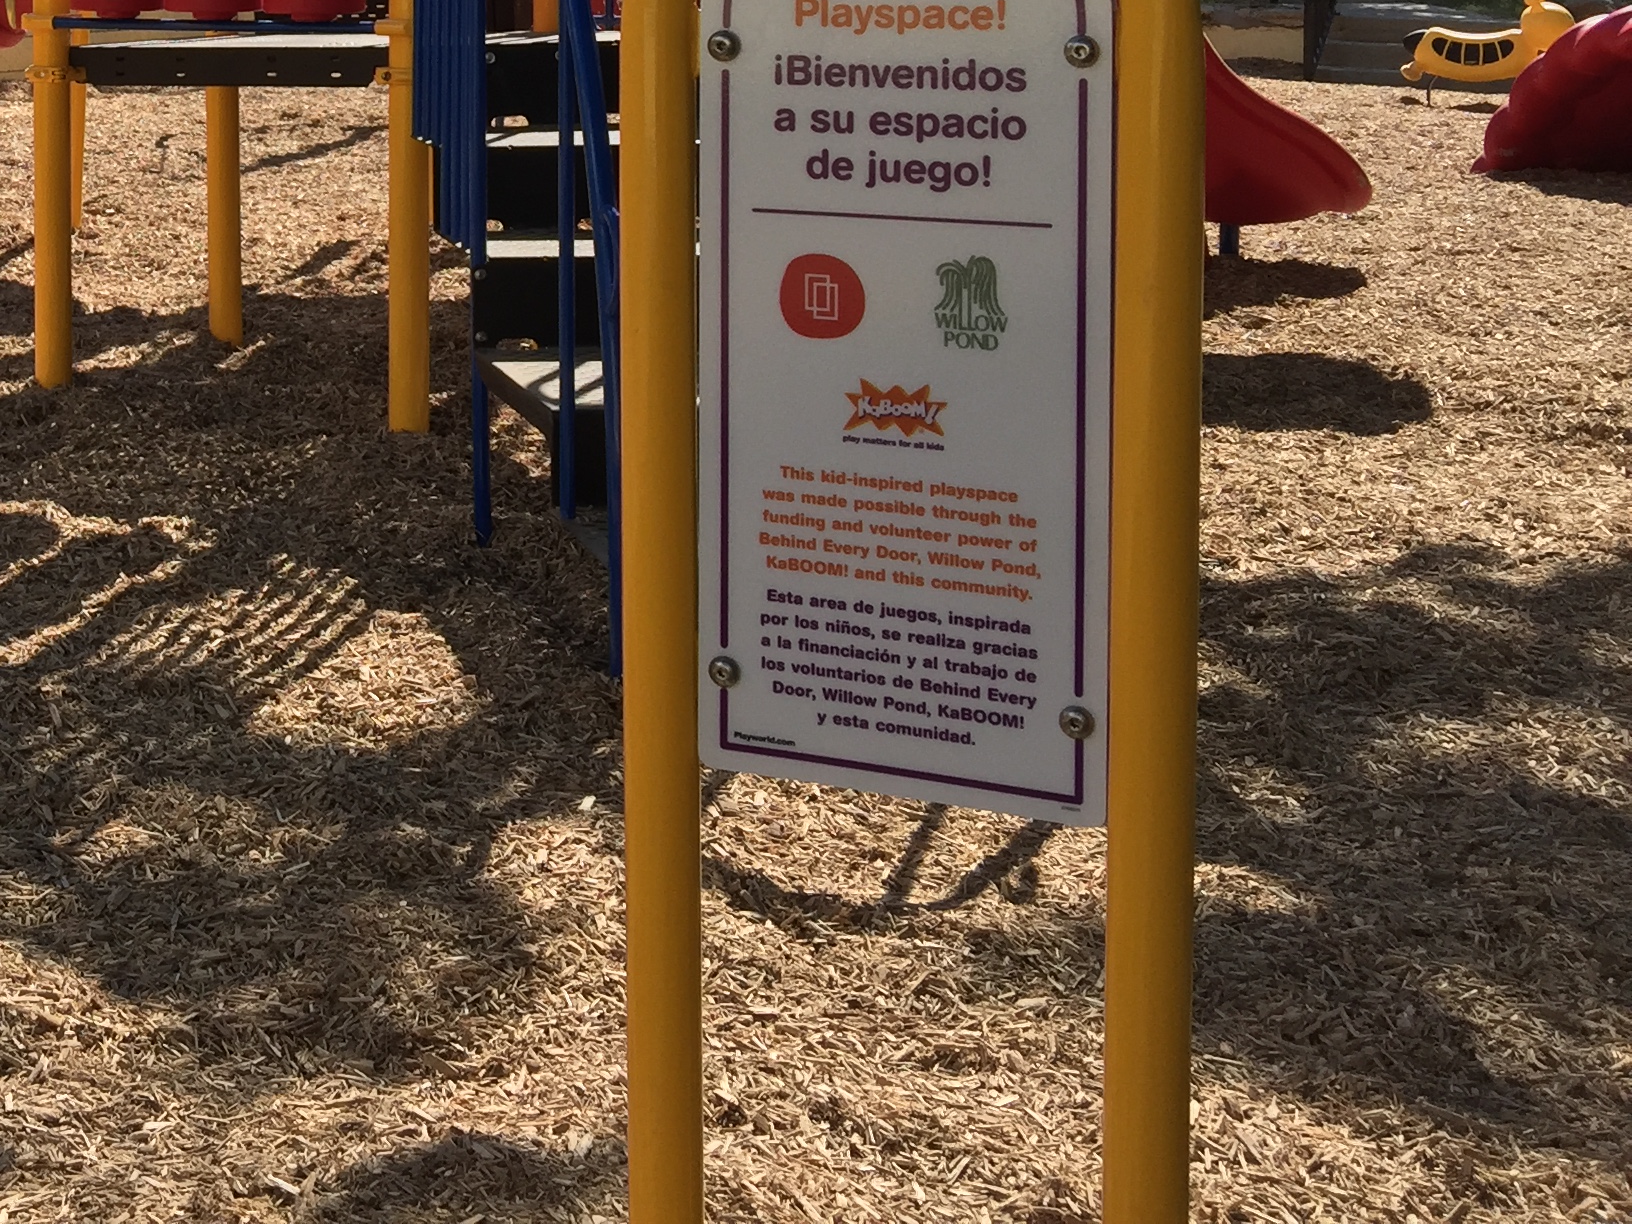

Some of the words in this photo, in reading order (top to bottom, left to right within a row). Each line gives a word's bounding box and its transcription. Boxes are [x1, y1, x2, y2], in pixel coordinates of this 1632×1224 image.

[774, 108, 796, 132] a
[810, 110, 854, 134] su
[869, 107, 1026, 143] espacio
[806, 149, 854, 181] de
[865, 150, 991, 192] juego!
[934, 312, 1008, 333] WILLOW
[943, 331, 999, 351] POND
[843, 435, 860, 444] play
[863, 438, 896, 446] matters
[926, 442, 944, 451] kids
[780, 466, 814, 481] This
[821, 470, 923, 493] kid-inspired
[930, 482, 1018, 503] playspace
[763, 490, 794, 502] was
[801, 494, 847, 508] made
[854, 500, 925, 516] possible
[932, 505, 1001, 526] through
[1009, 513, 1037, 528] the
[763, 509, 825, 531] funding
[832, 520, 863, 532] and
[869, 523, 951, 542] volunteer
[958, 534, 1012, 549] power
[1019, 539, 1037, 552] of
[759, 532, 816, 550] Behind
[823, 539, 869, 559] Every
[876, 545, 921, 565] Door,
[927, 552, 984, 570] Willow
[992, 559, 1041, 579] Pond,
[767, 555, 848, 577] KaBOOM!
[854, 569, 886, 582] and
[892, 571, 924, 586] this
[931, 578, 1032, 602] community.
[767, 589, 803, 605] Esta
[809, 597, 847, 611] area
[853, 600, 874, 614] de
[879, 602, 942, 625] juegos,
[949, 611, 1031, 635] inspirada
[760, 614, 789, 626] por
[795, 615, 819, 630] los
[826, 619, 875, 640] niños,
[882, 629, 901, 641] se
[908, 633, 966, 649] realiza
[973, 641, 1038, 659] gracias
[761, 636, 771, 647] a
[777, 635, 791, 649] la
[798, 638, 900, 664] financiación
[907, 656, 916, 669] y
[922, 656, 938, 670] al
[944, 659, 1008, 680] trabajo
[1015, 668, 1037, 683] de
[761, 656, 785, 671] los
[791, 663, 886, 685] voluntarios
[892, 675, 913, 689] de
[920, 678, 980, 699] Behind
[988, 688, 1037, 710] Every
[773, 680, 816, 701] Door,
[822, 687, 877, 707] Willow
[884, 696, 931, 718] Pond,
[938, 704, 1024, 729] KaBOOM!
[733, 731, 796, 747] Playworld.com
[817, 713, 827, 725] y
[832, 715, 869, 729] esta
[876, 721, 975, 745] comunidad.
